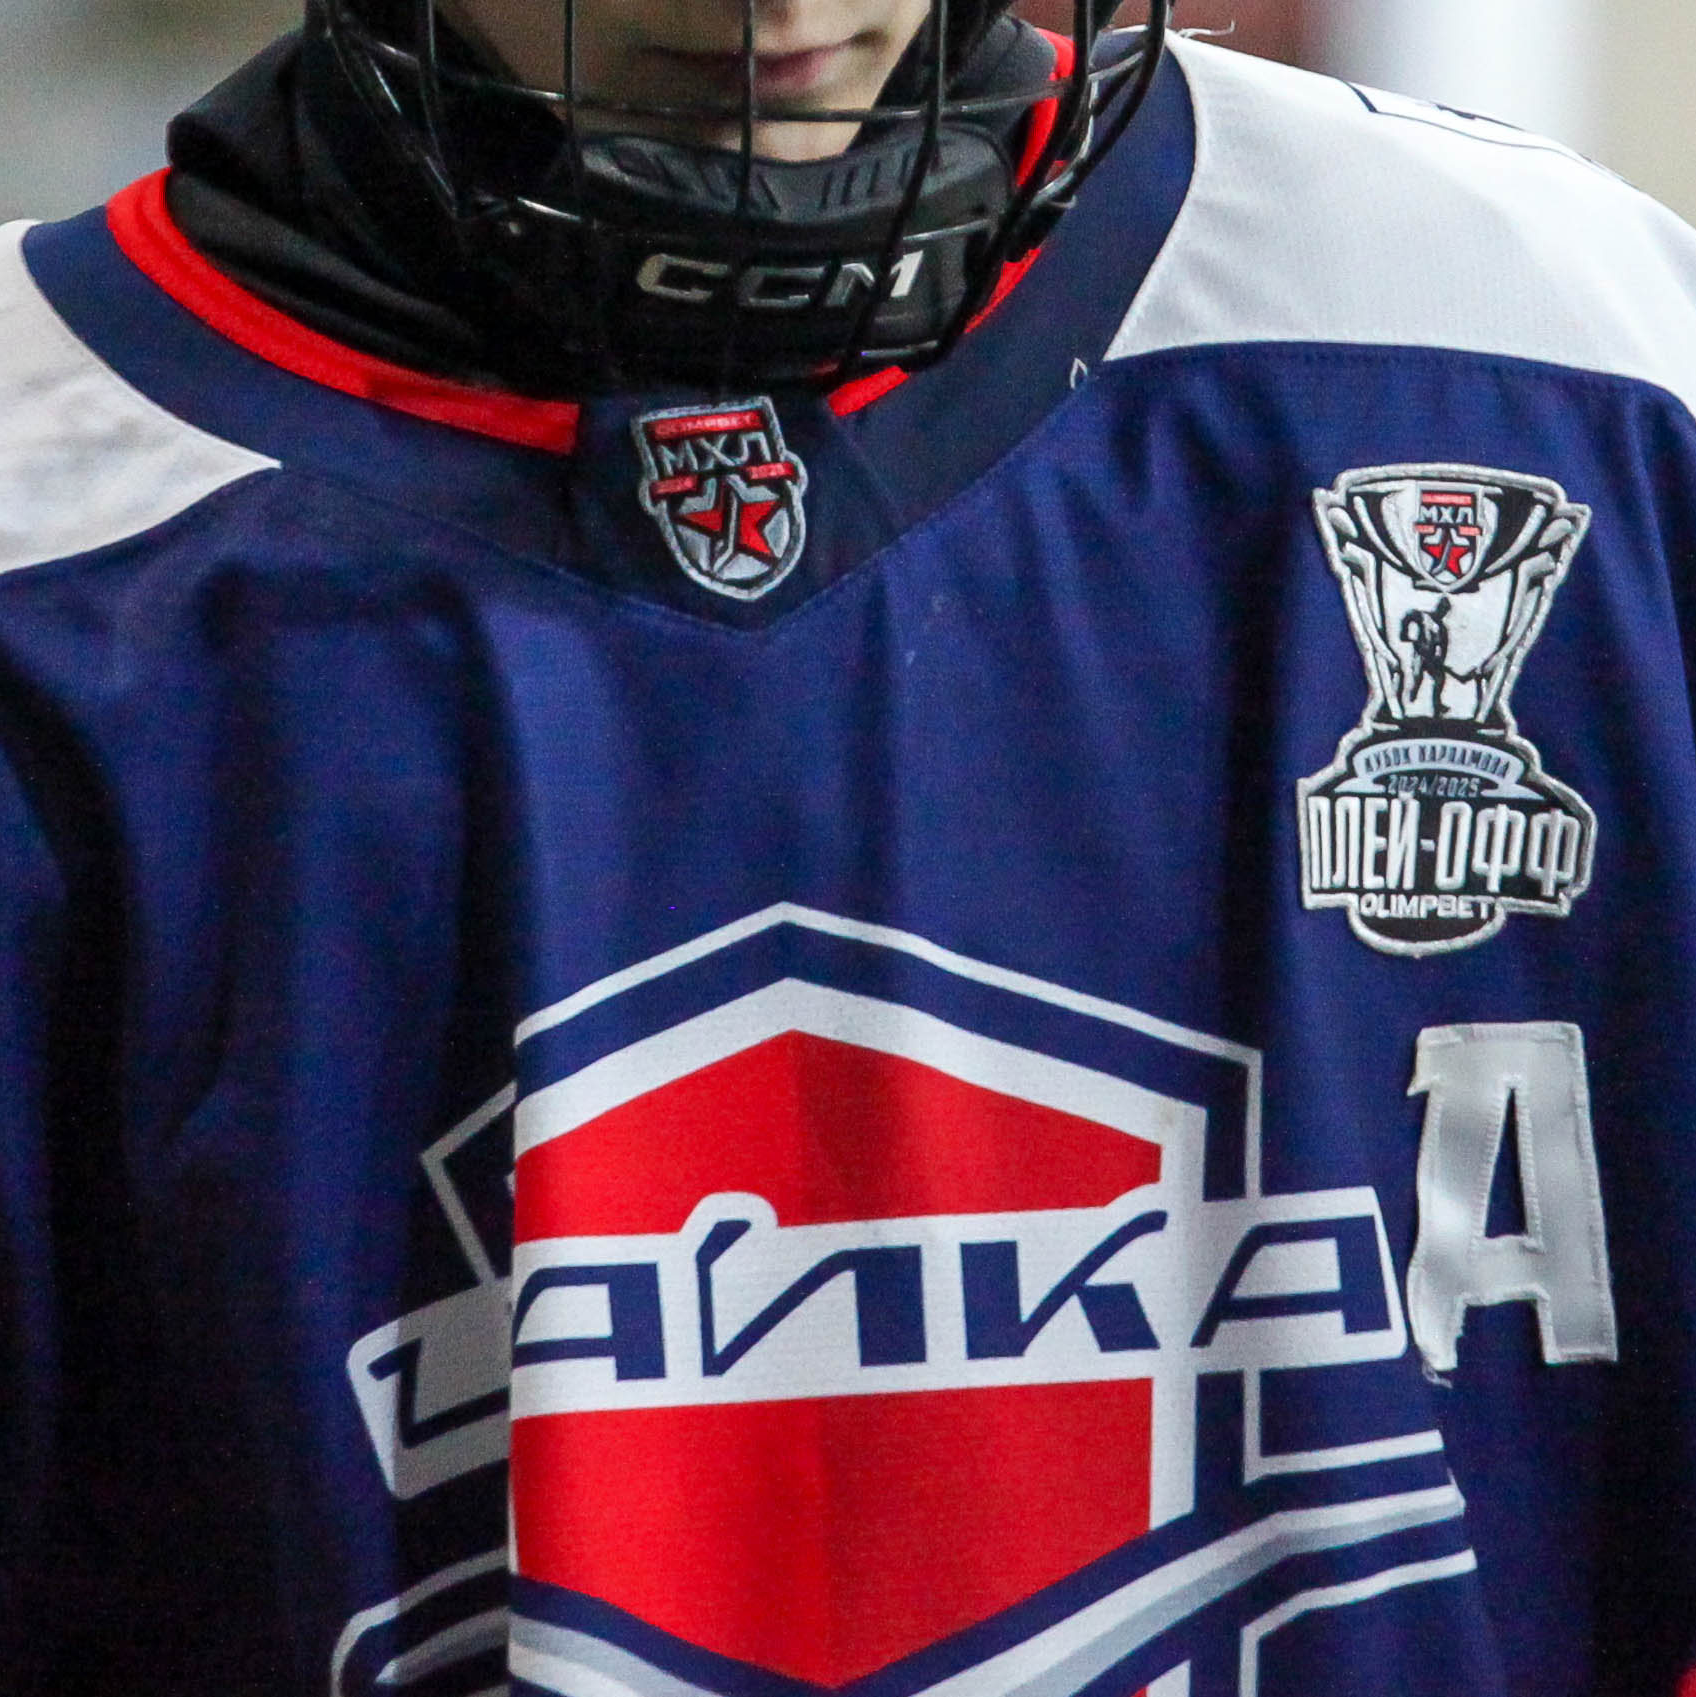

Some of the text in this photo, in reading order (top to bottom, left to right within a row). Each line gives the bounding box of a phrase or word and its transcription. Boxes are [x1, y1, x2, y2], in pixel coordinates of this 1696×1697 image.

[635, 248, 925, 308] CCM
[658, 432, 771, 474] МХЛ
[1417, 505, 1475, 525] МХЛ
[1386, 775, 1482, 798] 2024/2025
[1306, 796, 1582, 896] ПЛЕЙ-ОФФ
[1359, 893, 1496, 920] OLIMPBET
